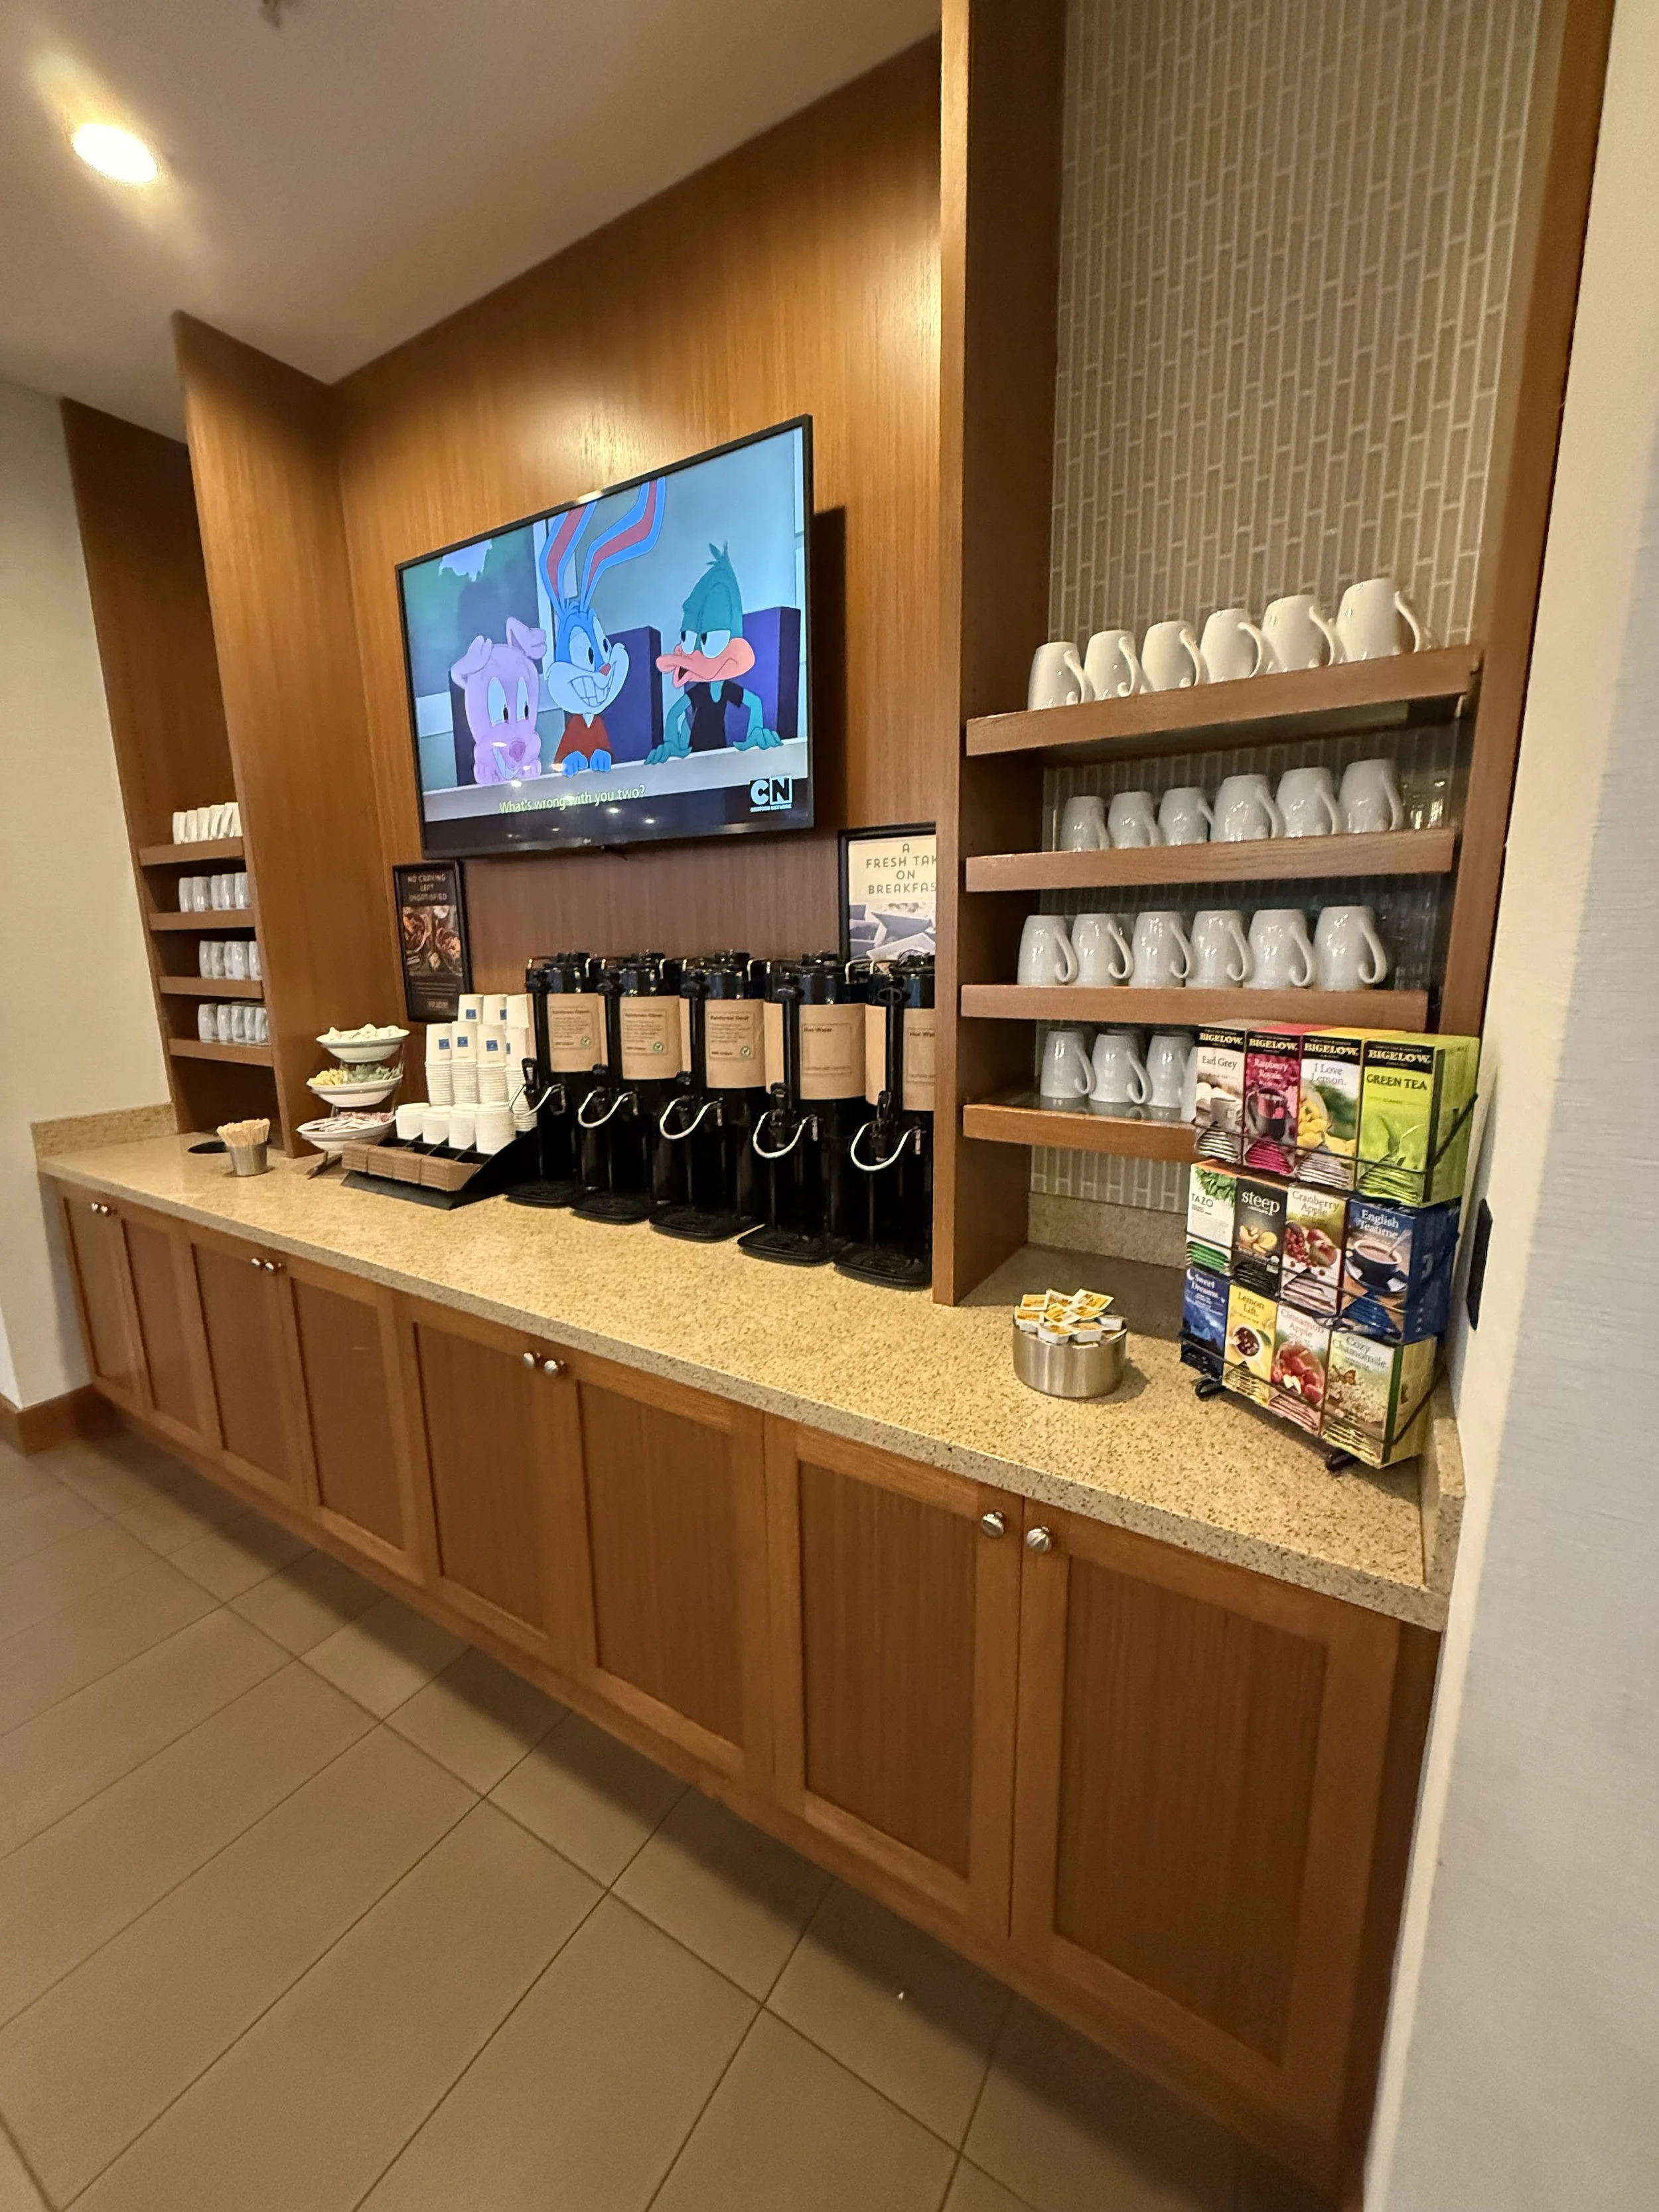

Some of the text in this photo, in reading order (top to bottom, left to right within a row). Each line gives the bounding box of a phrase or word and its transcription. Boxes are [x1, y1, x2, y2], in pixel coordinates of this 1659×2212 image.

[500, 784, 646, 814] What's wrong with you two?
[751, 775, 792, 806] CN
[902, 843, 910, 853] A
[866, 857, 907, 869] FRESH
[896, 869, 916, 881] ON
[1202, 1055, 1238, 1070] Earl Grey
[1314, 1063, 1344, 1076] I Love
[1366, 1074, 1428, 1090] GREEN TEA
[1191, 1193, 1214, 1208] TAZO
[1241, 1191, 1281, 1217] steep
[1292, 1190, 1340, 1213] Cranberry
[1301, 1203, 1328, 1218] Apple
[1361, 1209, 1400, 1228] English
[1356, 1218, 1399, 1240] Teatime
[1238, 1291, 1265, 1309] Lemon
[1281, 1308, 1325, 1334] Cinnamon
[1289, 1322, 1313, 1338] Apple
[1333, 1339, 1387, 1368] Chamomile
[1346, 1335, 1372, 1355] Cozy
